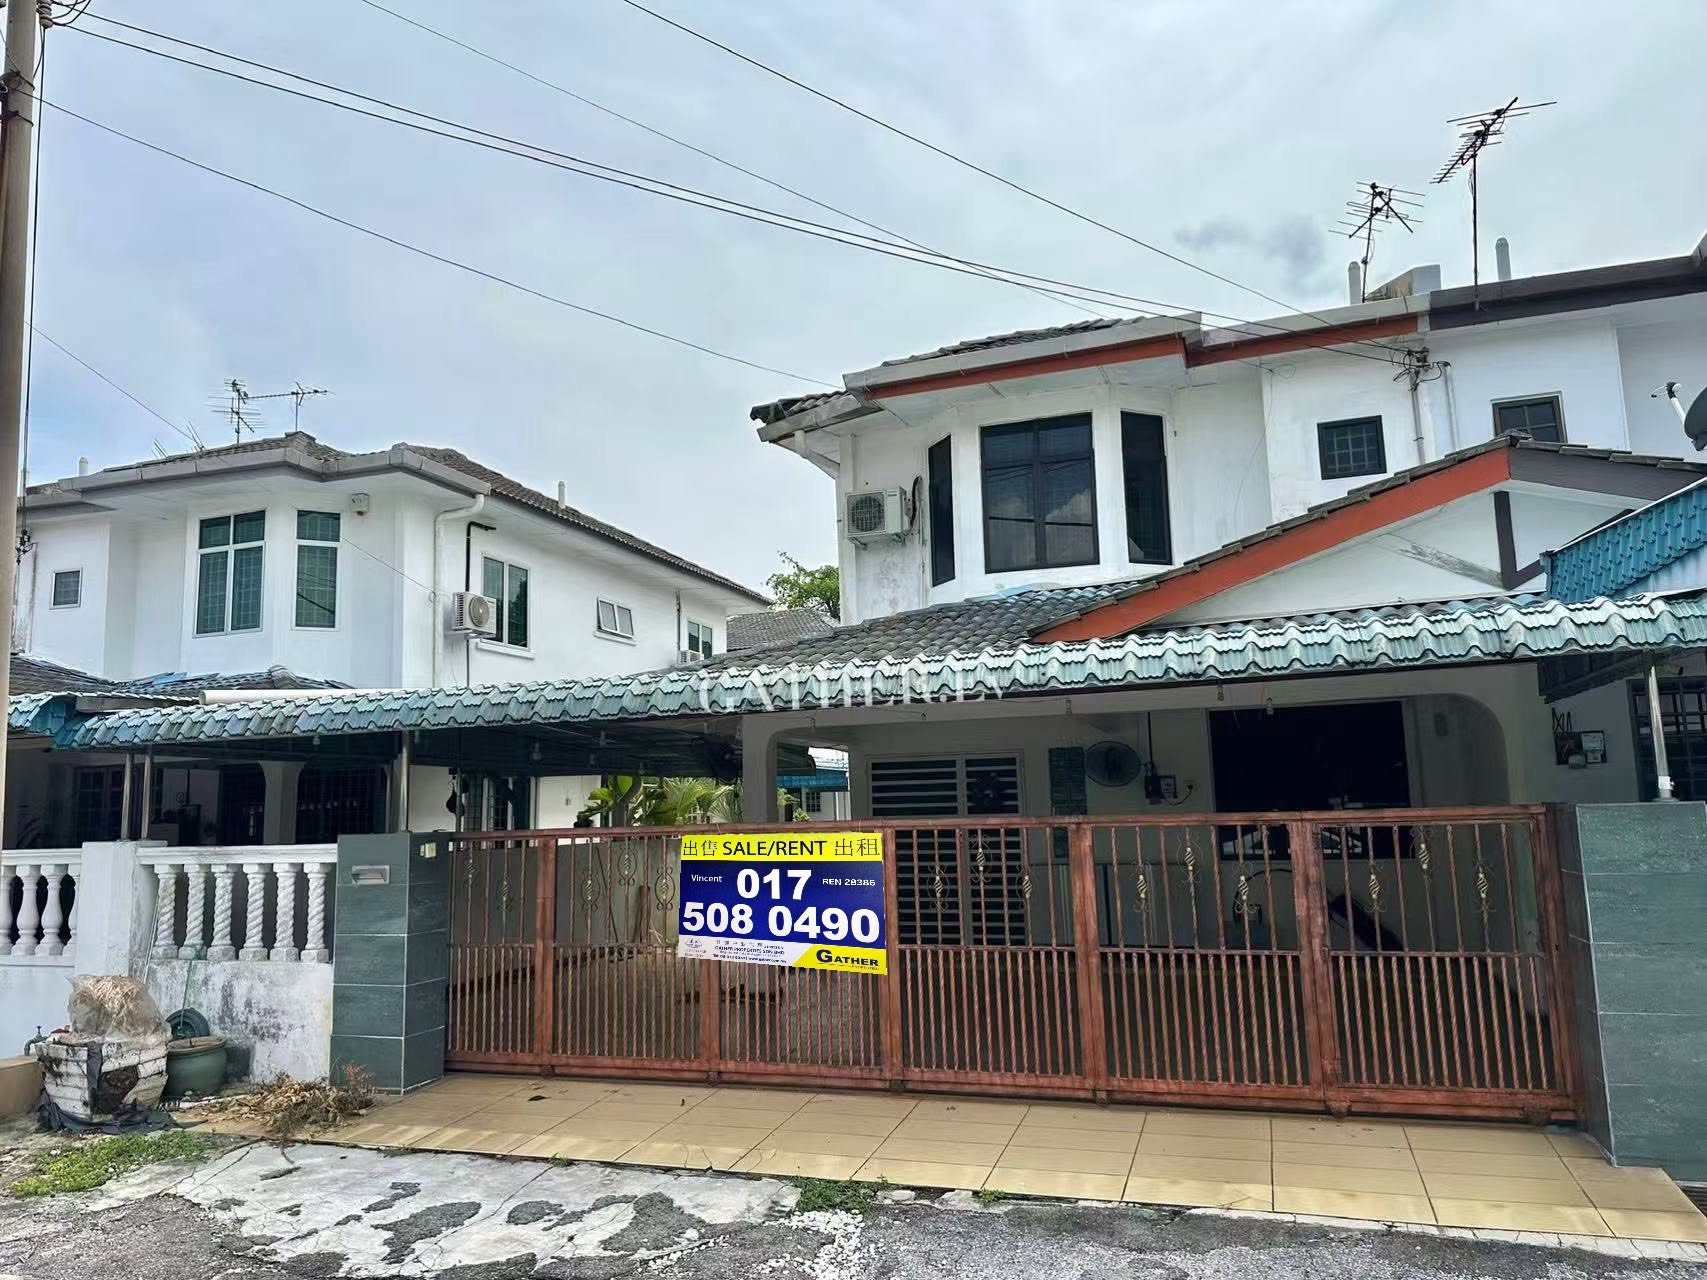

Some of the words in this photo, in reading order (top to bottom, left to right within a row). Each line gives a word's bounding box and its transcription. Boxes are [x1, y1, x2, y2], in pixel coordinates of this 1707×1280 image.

[683, 840, 717, 857] 出售
[723, 841, 827, 856] SALE/RENT
[835, 838, 880, 857] 出租
[691, 874, 722, 883] Vincent
[737, 868, 812, 900] 017
[822, 878, 842, 886] REN
[683, 902, 753, 934] 508
[768, 905, 880, 943] 0490
[816, 949, 879, 967] GATHER
